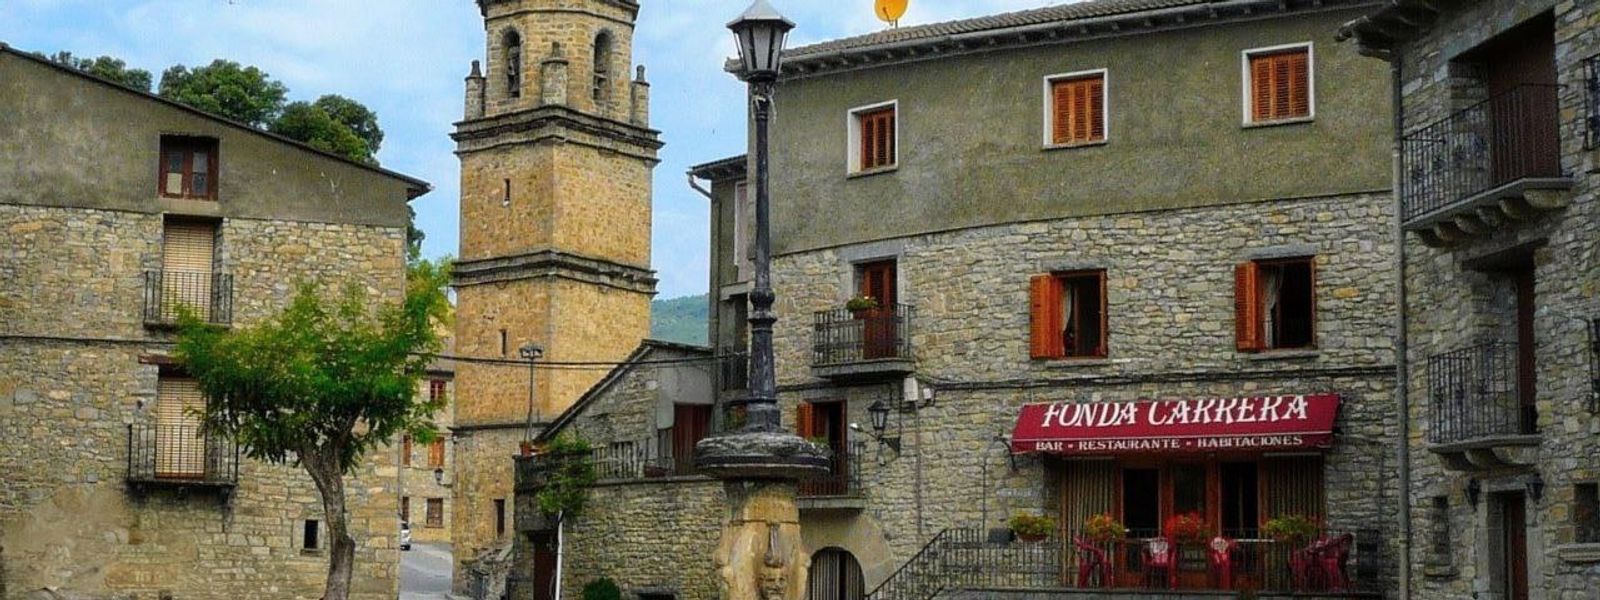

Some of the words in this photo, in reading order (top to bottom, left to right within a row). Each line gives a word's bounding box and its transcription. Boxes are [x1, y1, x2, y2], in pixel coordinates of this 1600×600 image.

[1041, 402, 1138, 427] FONDA
[1148, 395, 1308, 425] CARRERA
[1036, 441, 1063, 451] BAR
[1079, 439, 1180, 450] RESTAURANTE
[1197, 435, 1303, 448] HABITACIONES
